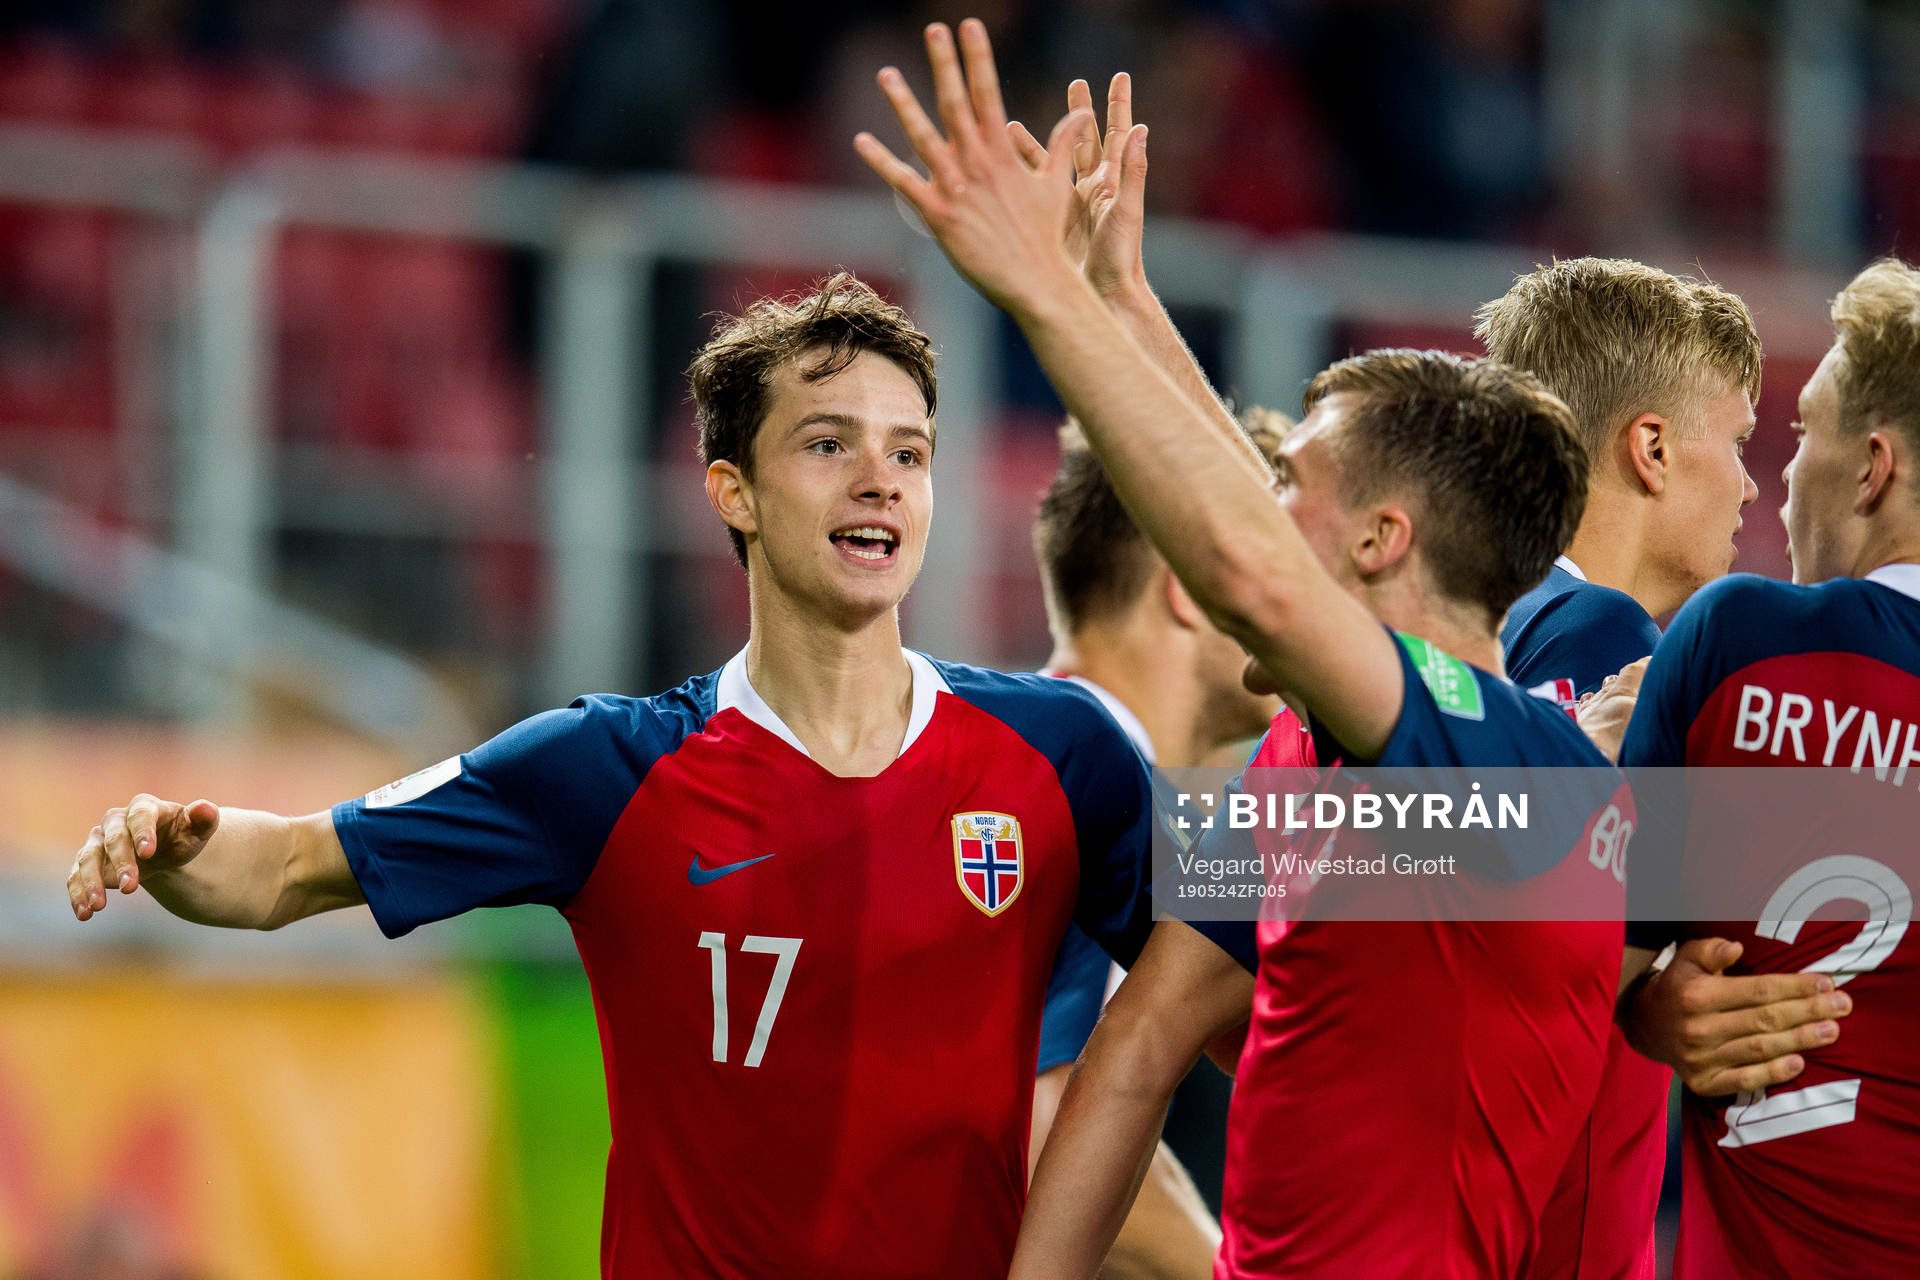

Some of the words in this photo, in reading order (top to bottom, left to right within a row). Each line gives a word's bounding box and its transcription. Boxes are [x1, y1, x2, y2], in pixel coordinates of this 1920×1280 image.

[975, 816, 997, 826] NORGE
[697, 931, 804, 1067] 17
[1718, 854, 1912, 1148] 2
